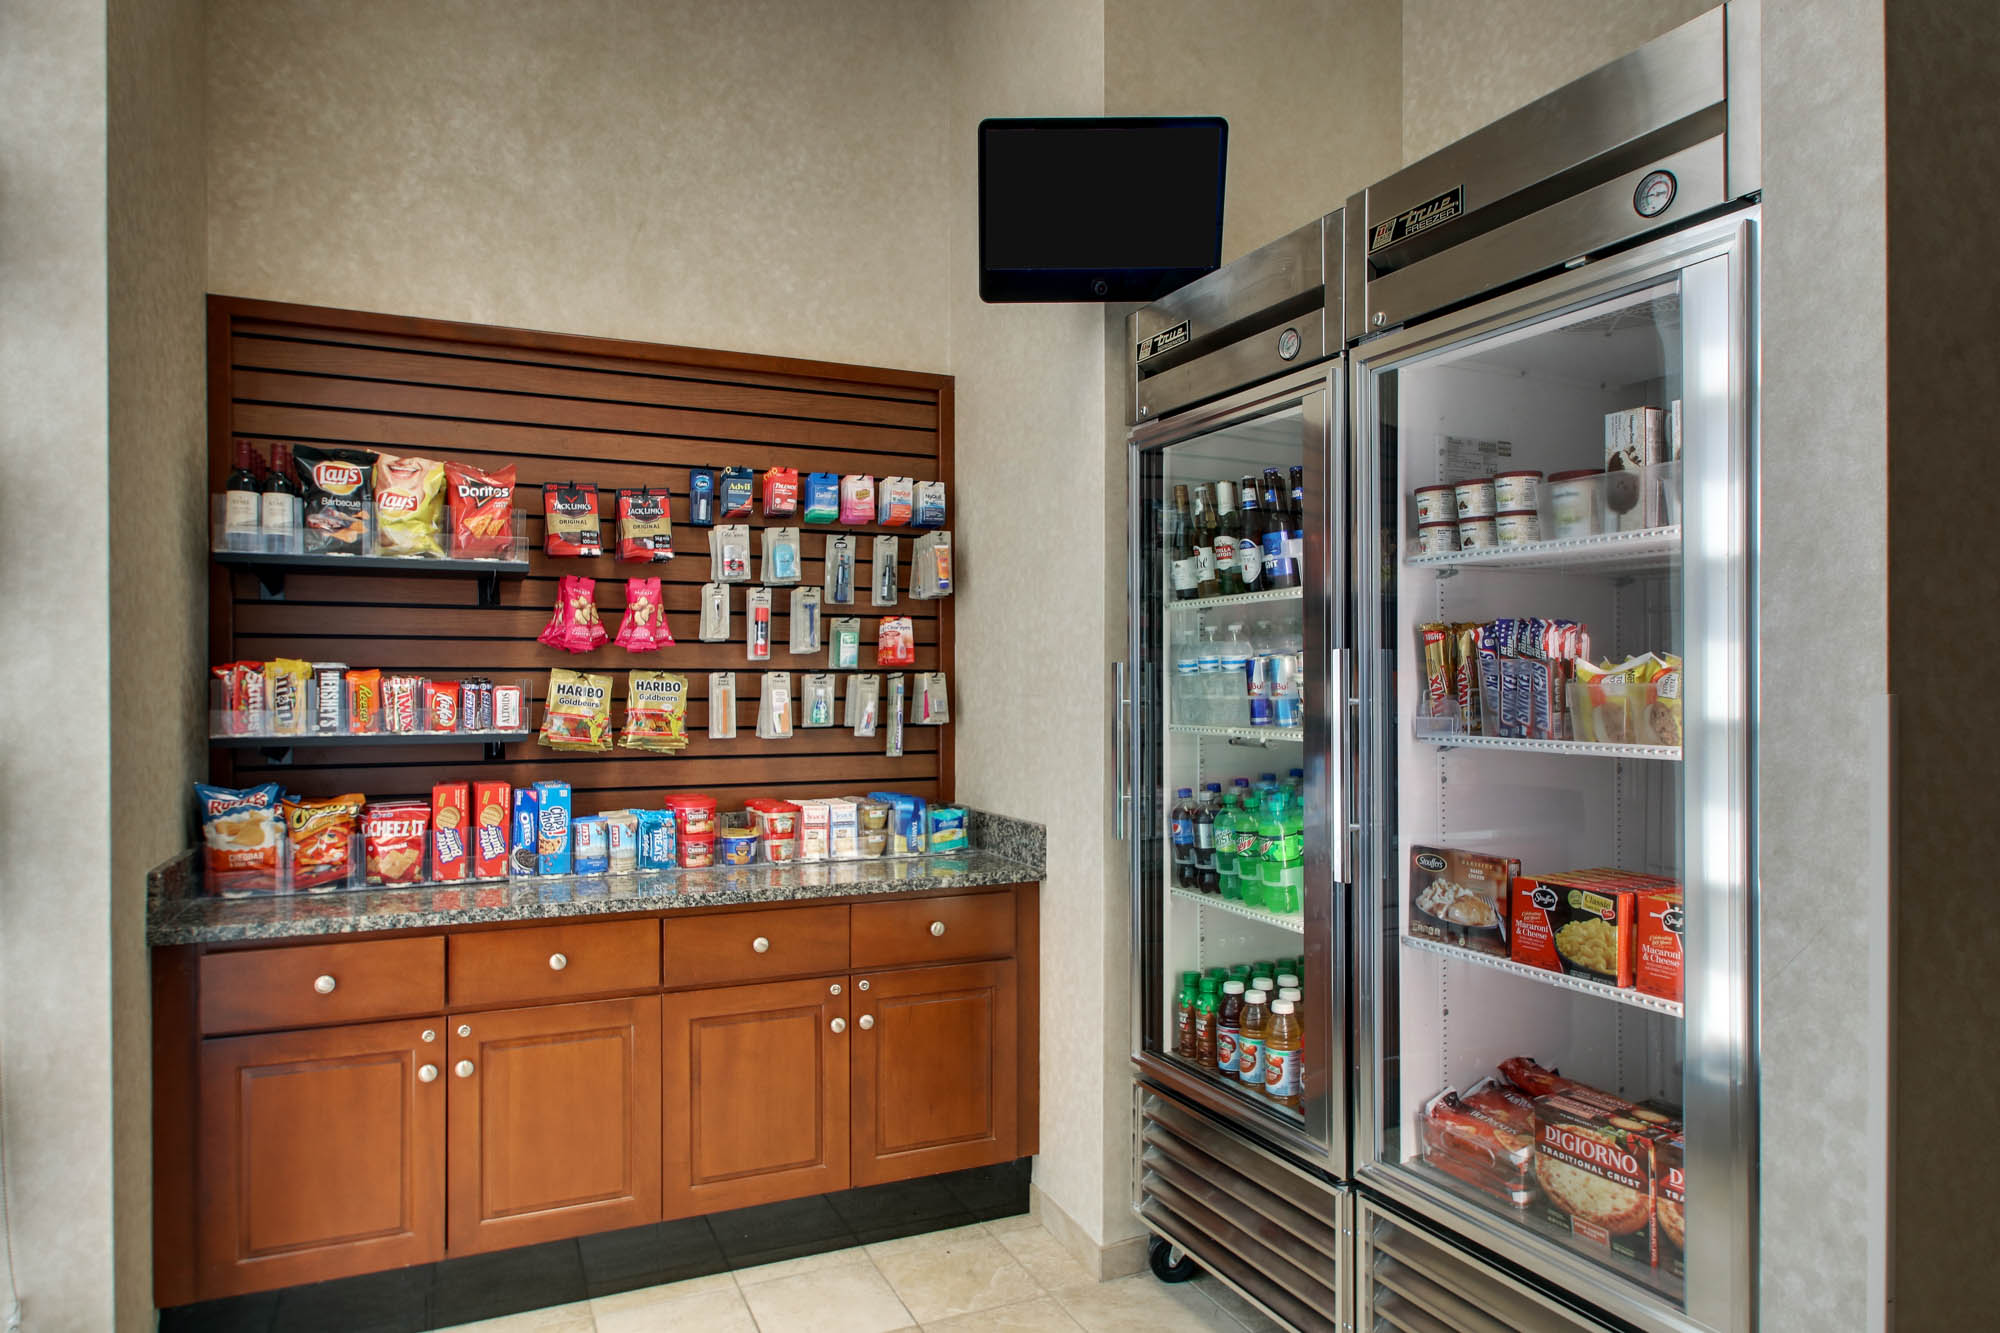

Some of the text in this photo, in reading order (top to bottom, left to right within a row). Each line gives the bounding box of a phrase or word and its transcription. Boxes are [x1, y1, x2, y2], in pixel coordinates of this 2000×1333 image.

[1405, 207, 1455, 236] FREEZER
[458, 485, 509, 498] Doritos
[728, 482, 751, 490] Advil
[321, 496, 361, 508] Barbecue
[553, 503, 571, 511] JACK
[557, 684, 604, 699] HARIBO
[636, 681, 681, 693] HARIBO
[559, 697, 600, 709] Goldbears
[639, 693, 678, 702] Goldbears
[397, 688, 414, 731] TWIX
[501, 692, 511, 723] ALTOIDS
[520, 812, 531, 846] OREO
[653, 829, 663, 862] TREATS
[1515, 919, 1549, 933] Macaroni
[1515, 927, 1548, 941] & Cheese
[1641, 943, 1681, 960] Macaroni
[1650, 956, 1681, 968] Cheese
[1541, 1144, 1604, 1176] TRADITIONAL
[1606, 1170, 1641, 1189] CRUST
